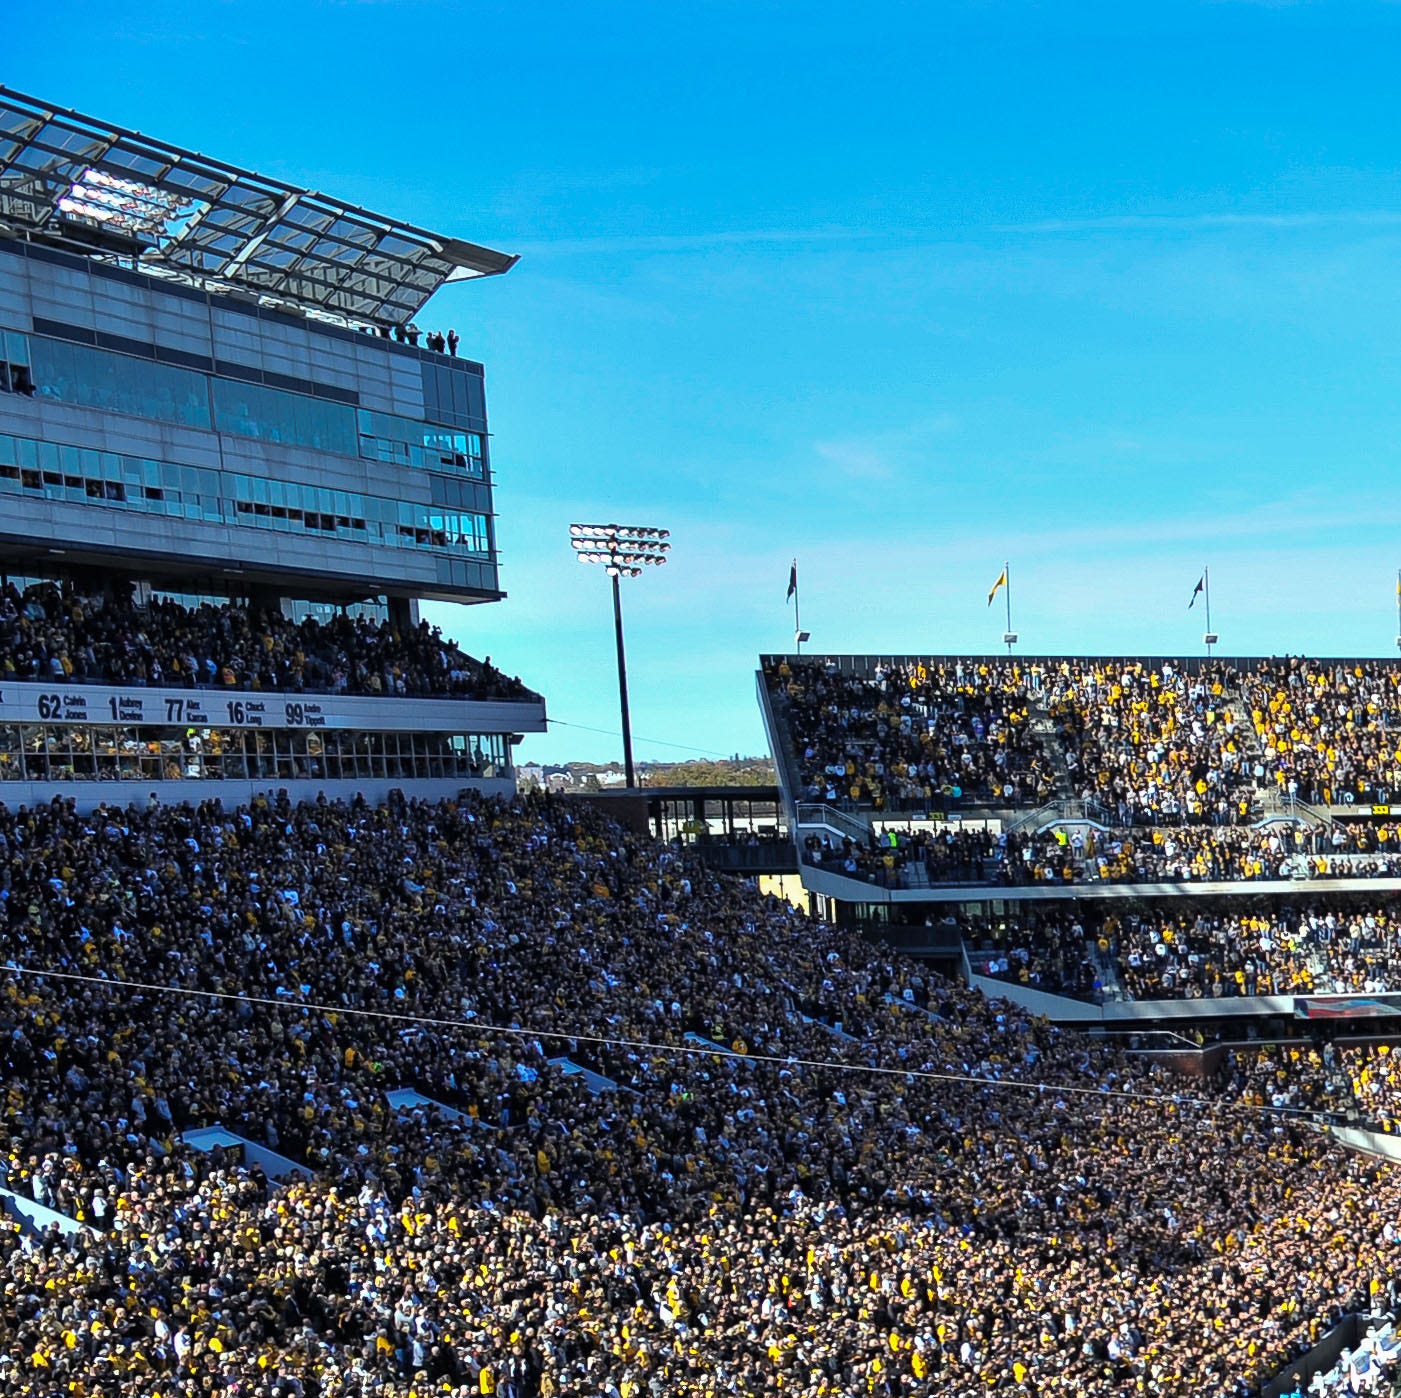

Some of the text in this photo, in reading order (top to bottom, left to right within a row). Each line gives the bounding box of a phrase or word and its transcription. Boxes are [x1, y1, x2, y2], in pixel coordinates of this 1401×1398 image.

[38, 694, 62, 719] 62
[65, 709, 87, 720] Jones
[109, 696, 118, 720] 1
[165, 699, 184, 722] 77
[227, 701, 245, 724] 16
[285, 703, 303, 725] 99
[246, 714, 262, 725] Long
